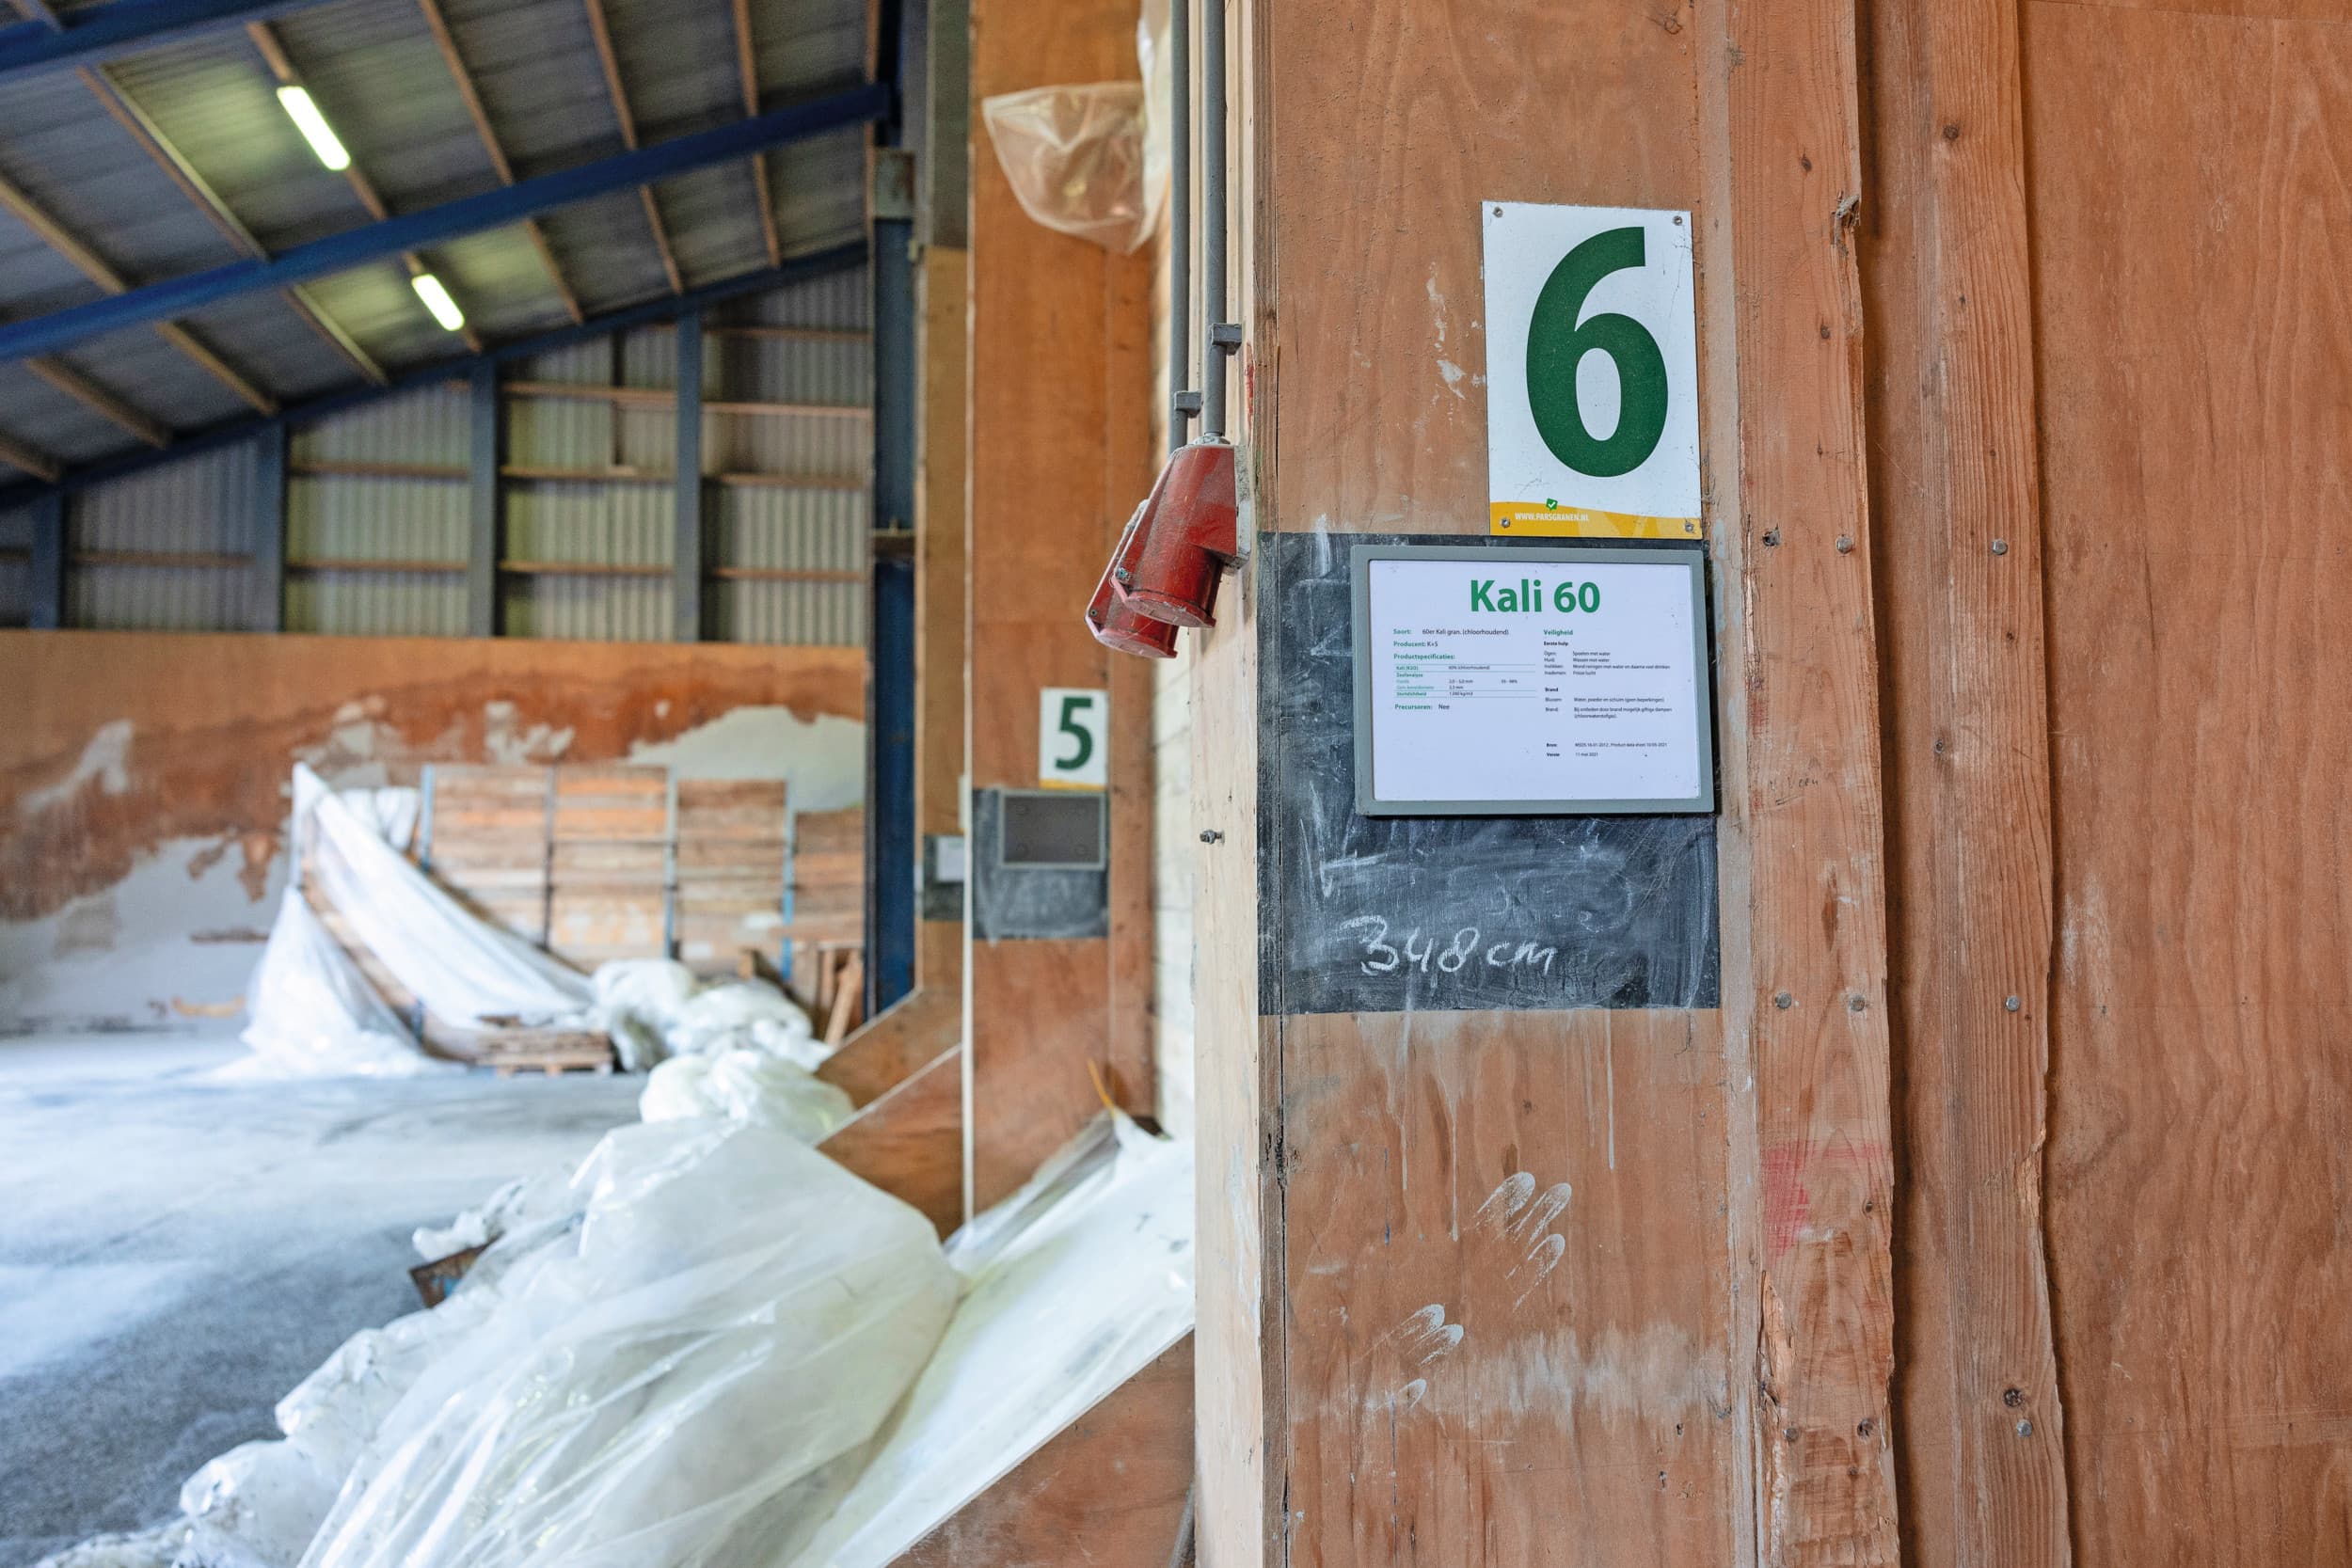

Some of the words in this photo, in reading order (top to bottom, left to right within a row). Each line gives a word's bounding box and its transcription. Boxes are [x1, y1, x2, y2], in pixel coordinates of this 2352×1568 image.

[1526, 226, 1669, 478] 6
[1470, 578, 1542, 612] Kali
[1554, 581, 1600, 613] 60
[1463, 628, 1509, 637] (chloorhoudend)
[1054, 697, 1094, 770] 5
[1339, 914, 1481, 975] 348
[1486, 940, 1559, 975] cm
